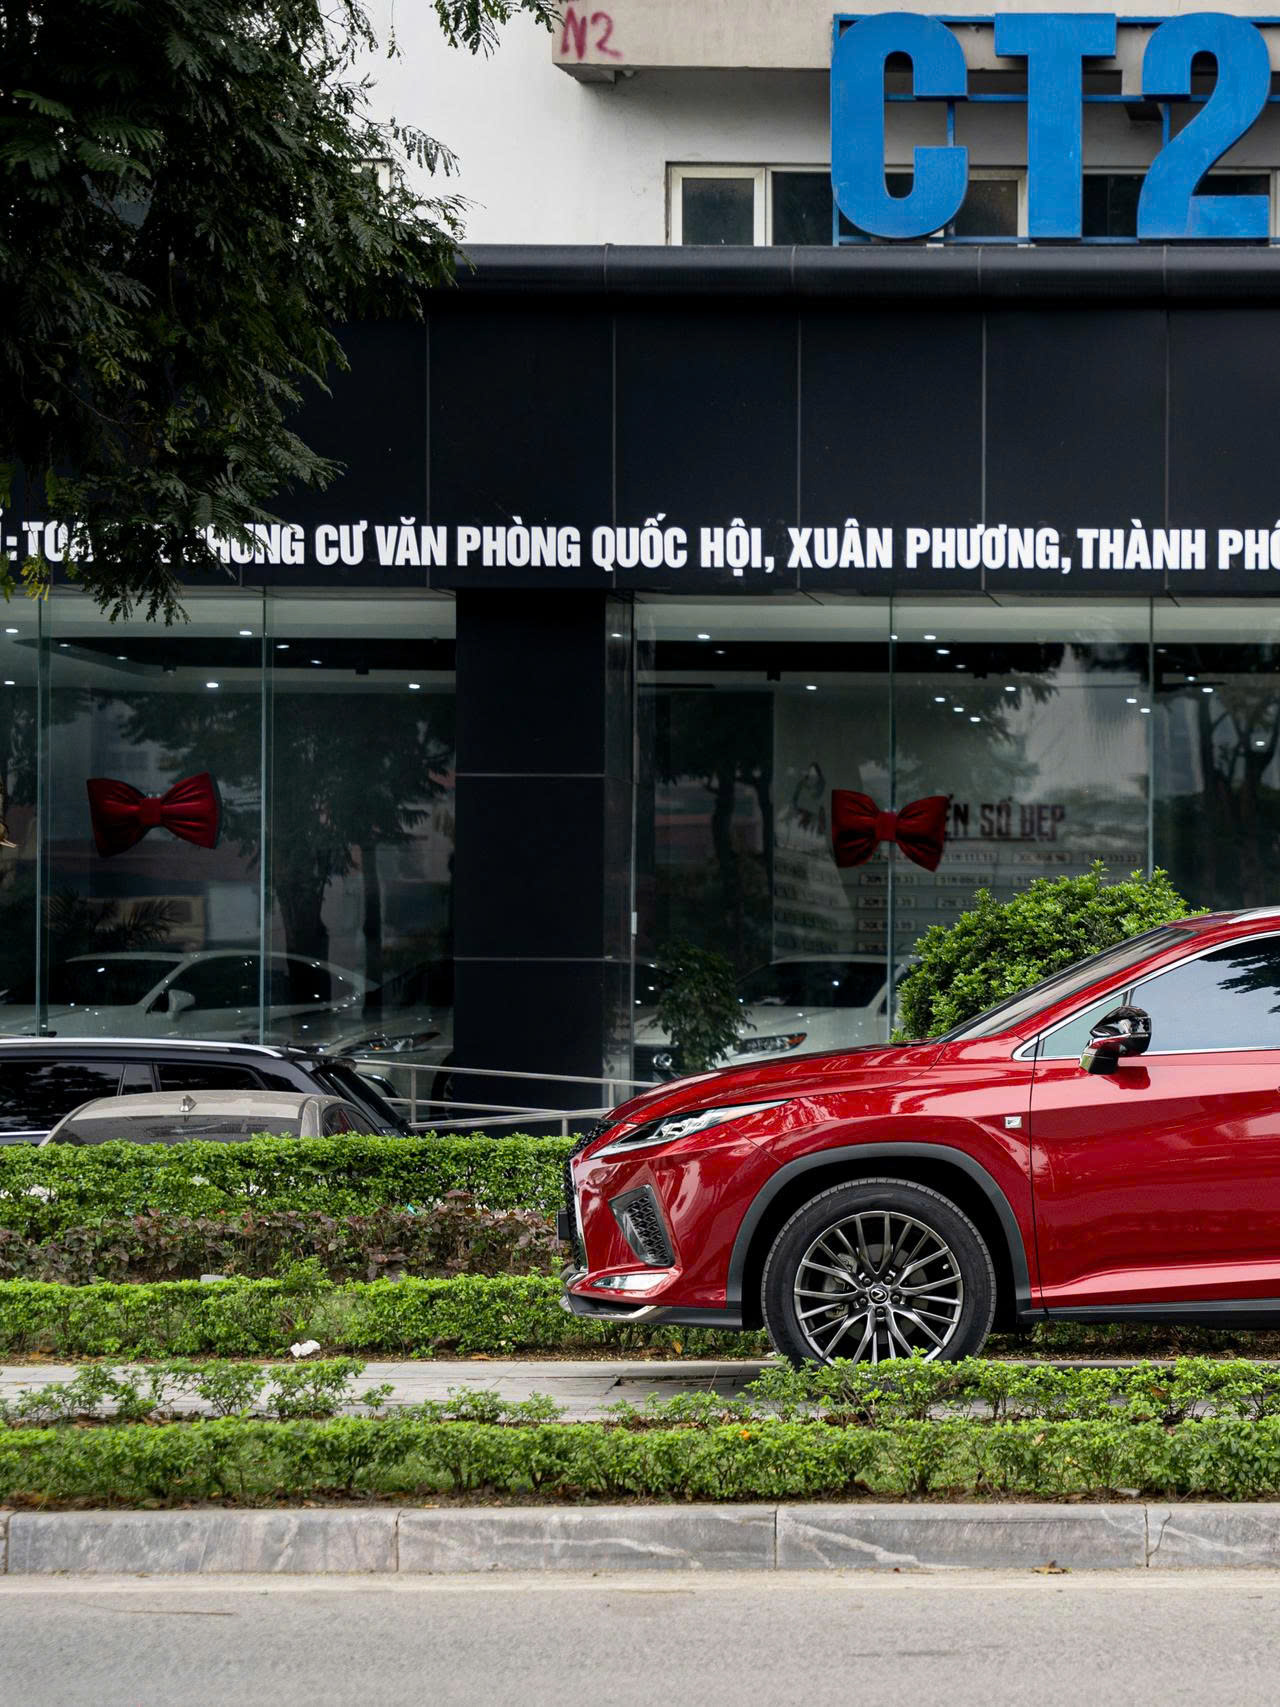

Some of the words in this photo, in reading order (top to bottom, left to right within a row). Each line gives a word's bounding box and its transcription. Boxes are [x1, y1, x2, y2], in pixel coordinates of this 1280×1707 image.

[561, 7, 623, 60] N2
[315, 519, 368, 566] CƯ
[374, 516, 448, 567] VĂN
[457, 515, 581, 568] PHÒNG
[591, 512, 688, 572] QUỐC
[700, 517, 775, 577] HỘI,
[786, 517, 893, 569] XUÂN
[905, 518, 1072, 575] PHƯƠNG,
[1077, 518, 1207, 571] THÀNH
